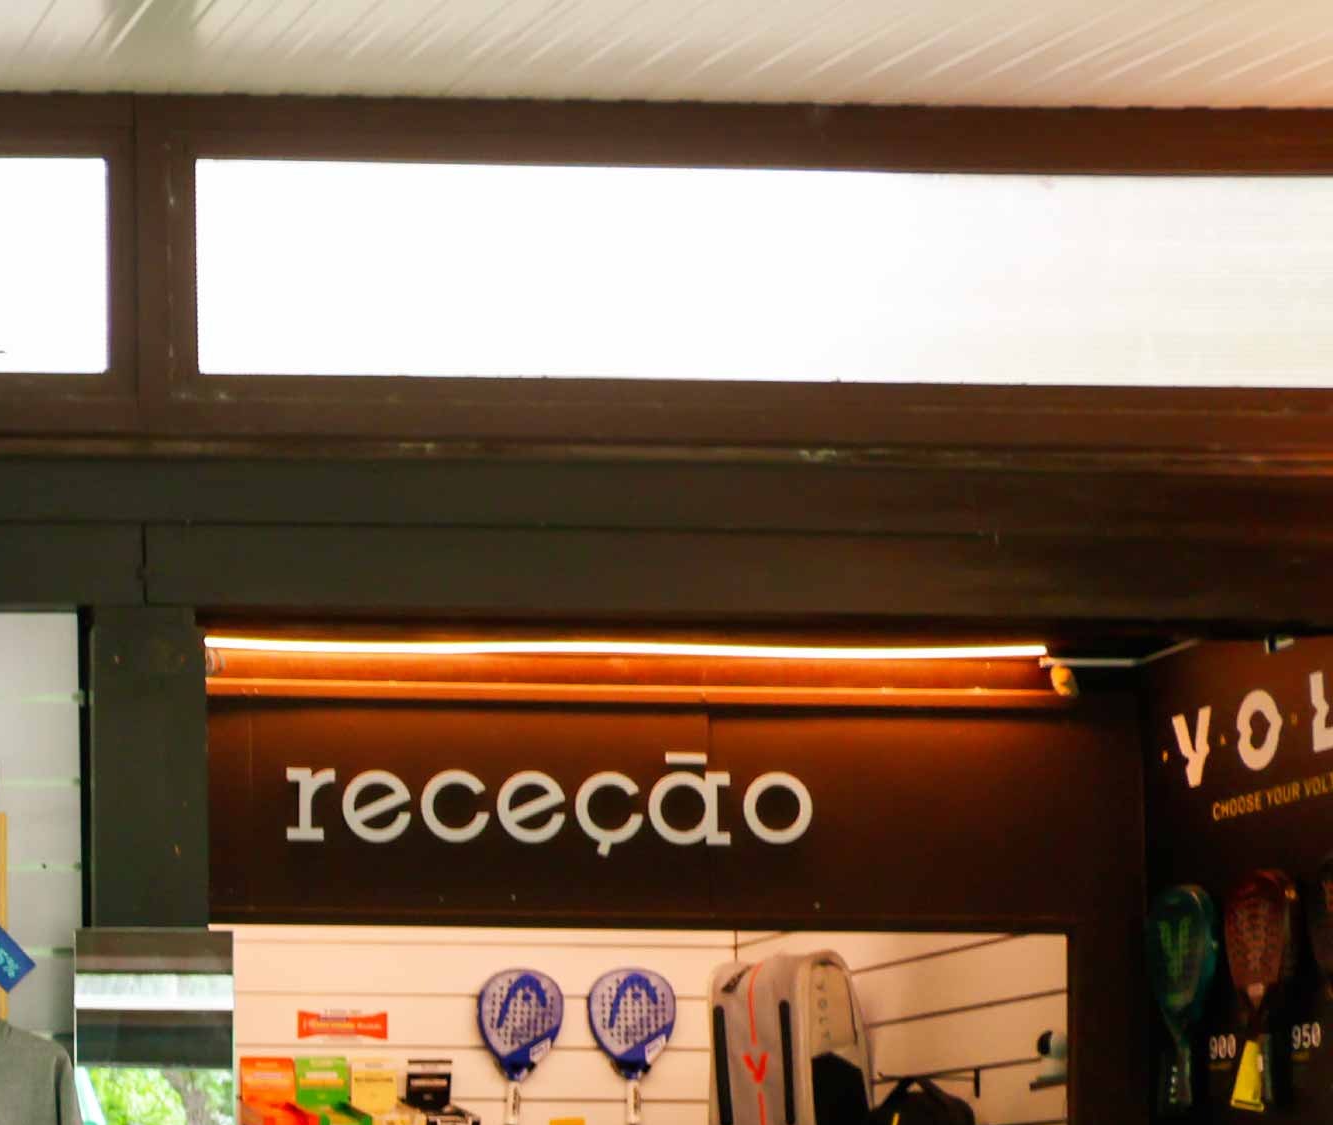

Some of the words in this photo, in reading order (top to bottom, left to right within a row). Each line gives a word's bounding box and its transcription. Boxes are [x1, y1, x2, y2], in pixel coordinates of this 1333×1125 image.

[1212, 790, 1262, 821] CHOOSE
[1265, 781, 1301, 806] YOUR
[1303, 771, 1333, 797] VOL
[1209, 1033, 1237, 1060] 900
[1291, 1022, 1321, 1050] 950
